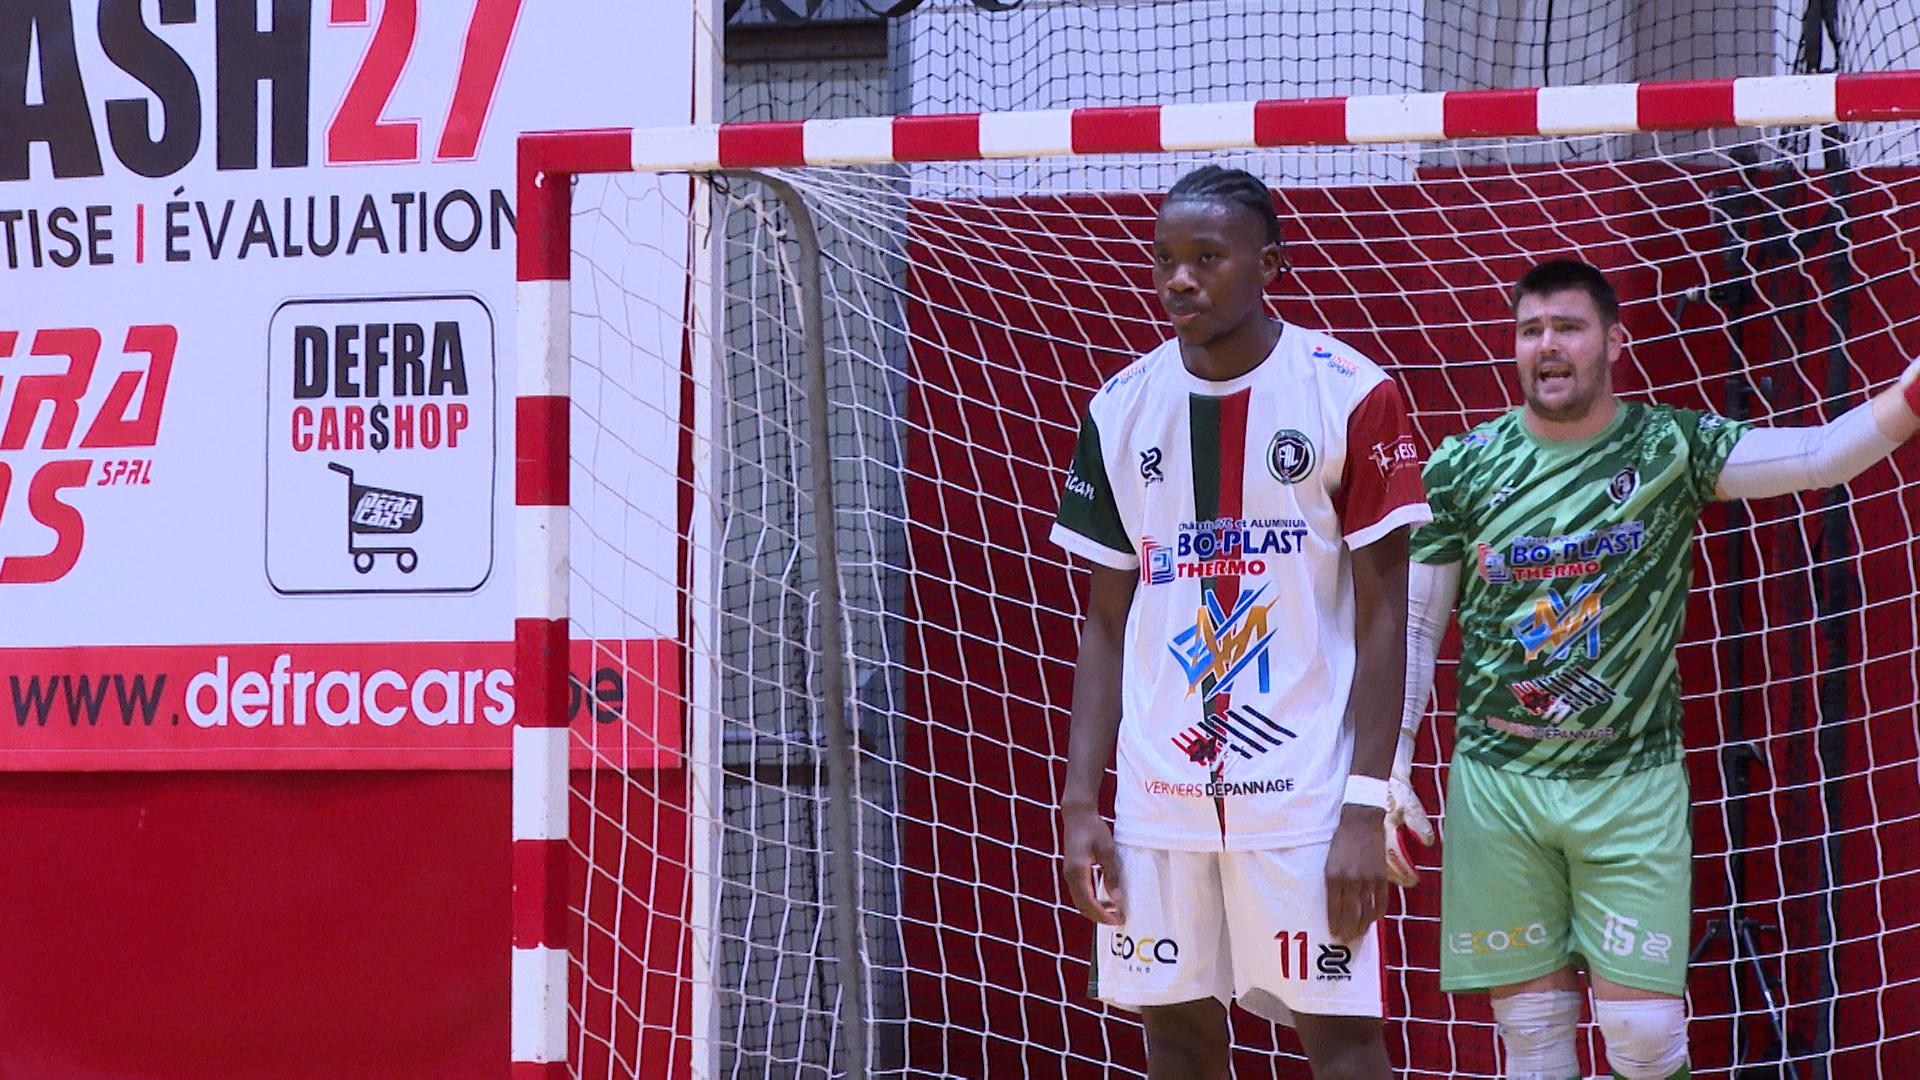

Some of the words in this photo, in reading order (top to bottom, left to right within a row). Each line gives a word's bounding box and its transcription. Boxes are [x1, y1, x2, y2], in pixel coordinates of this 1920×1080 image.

[0, 205, 114, 269] TISE
[294, 322, 468, 398] DEFRA
[1177, 559, 1266, 578] THERMO
[1512, 560, 1600, 582] THERMO
[1145, 780, 1203, 798] VERVIERS
[1273, 931, 1308, 980] 11
[1603, 912, 1639, 957] 15
